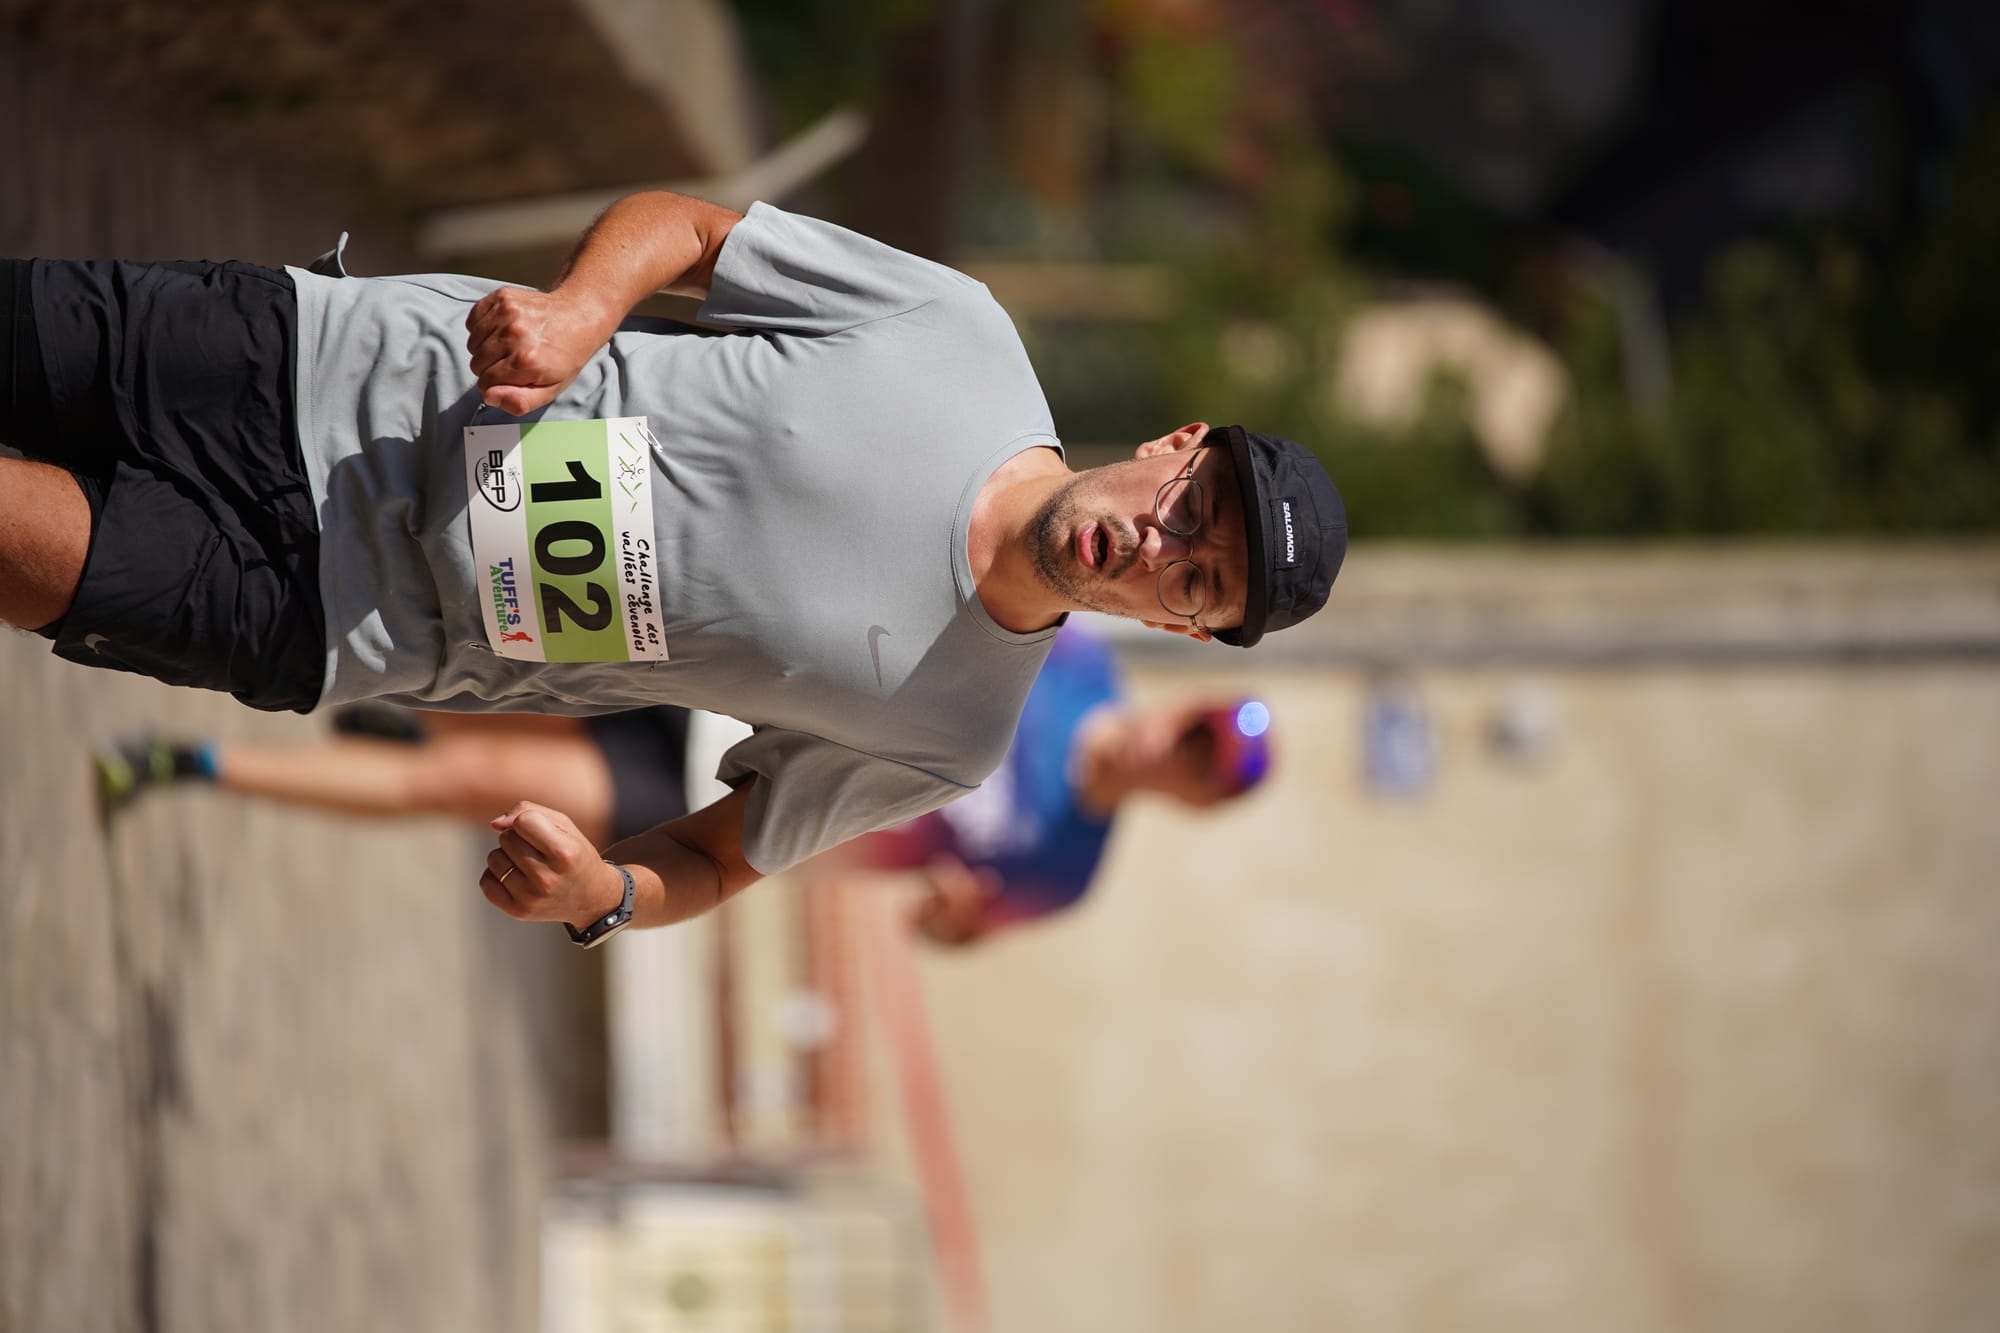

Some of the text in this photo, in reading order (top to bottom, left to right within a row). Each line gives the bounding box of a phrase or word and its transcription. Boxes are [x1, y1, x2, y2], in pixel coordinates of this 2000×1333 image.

[481, 462, 490, 488] GROUP
[488, 450, 506, 503] BFP
[530, 460, 612, 633] 102
[1283, 502, 1294, 562] SALOMON
[489, 564, 509, 632] Aventure
[499, 557, 521, 625] TUFF'S
[621, 531, 645, 652] vallées cévenoles
[637, 538, 659, 645] Challenge des
